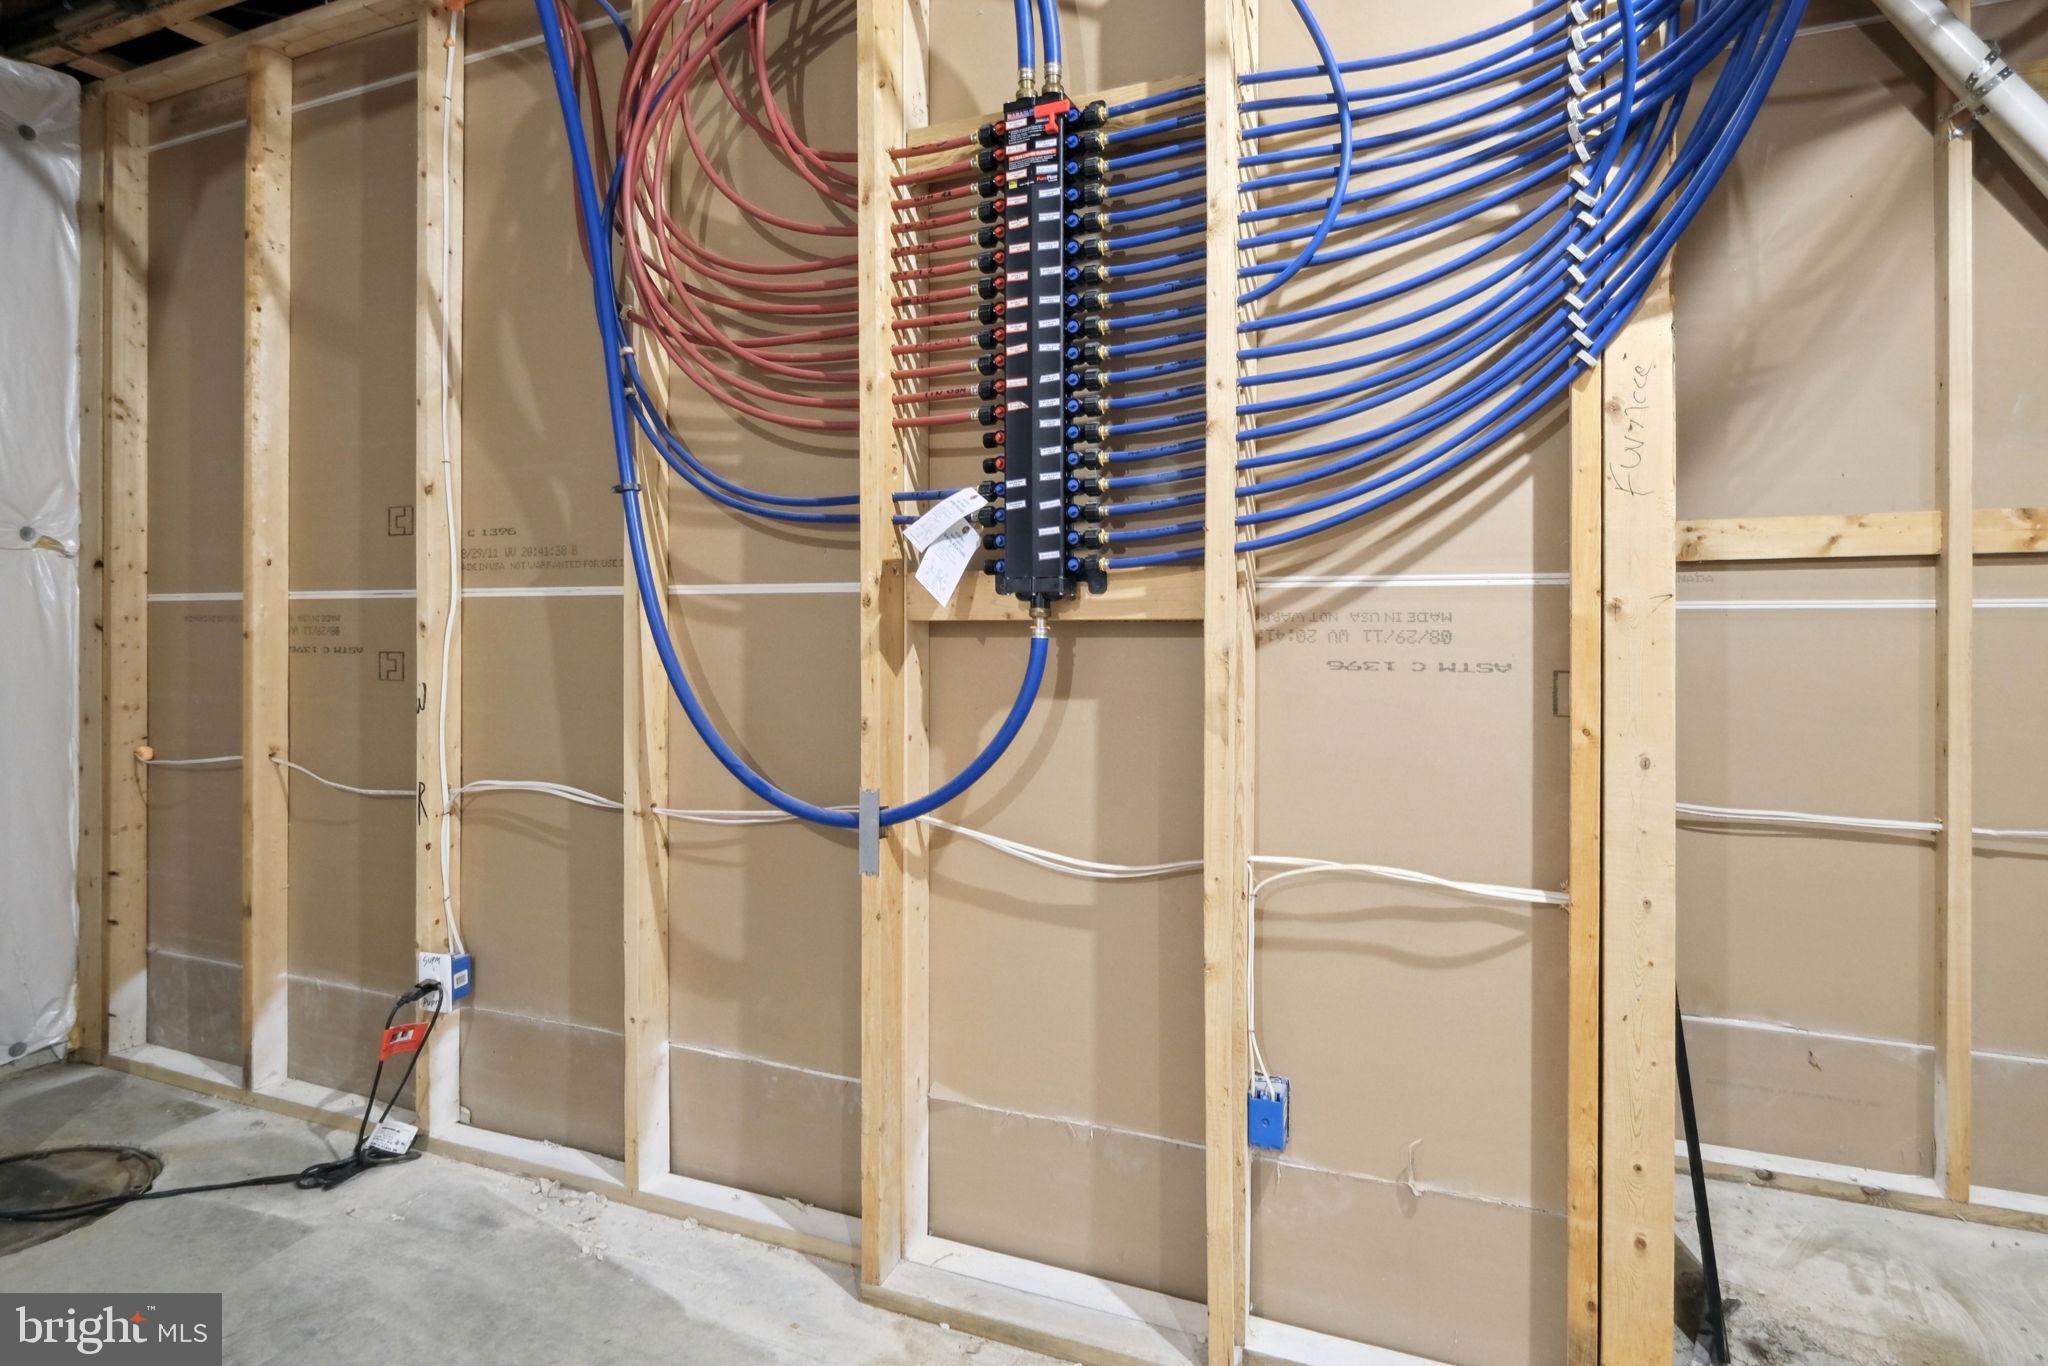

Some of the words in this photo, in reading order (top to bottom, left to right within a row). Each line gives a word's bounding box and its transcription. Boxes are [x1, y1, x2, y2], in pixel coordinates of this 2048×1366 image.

[482, 527, 517, 537] 1396
[461, 547, 498, 559] 8/29/11
[462, 562, 477, 571] ADE
[1677, 574, 1714, 584] NADA
[1350, 611, 1381, 623] USA
[1384, 611, 1402, 623] IN
[1407, 611, 1452, 623] MADE
[1362, 629, 1453, 645] 08/29/11
[1326, 660, 1397, 673] 1396
[1412, 661, 1427, 673] C
[1438, 661, 1513, 674] ASTM
